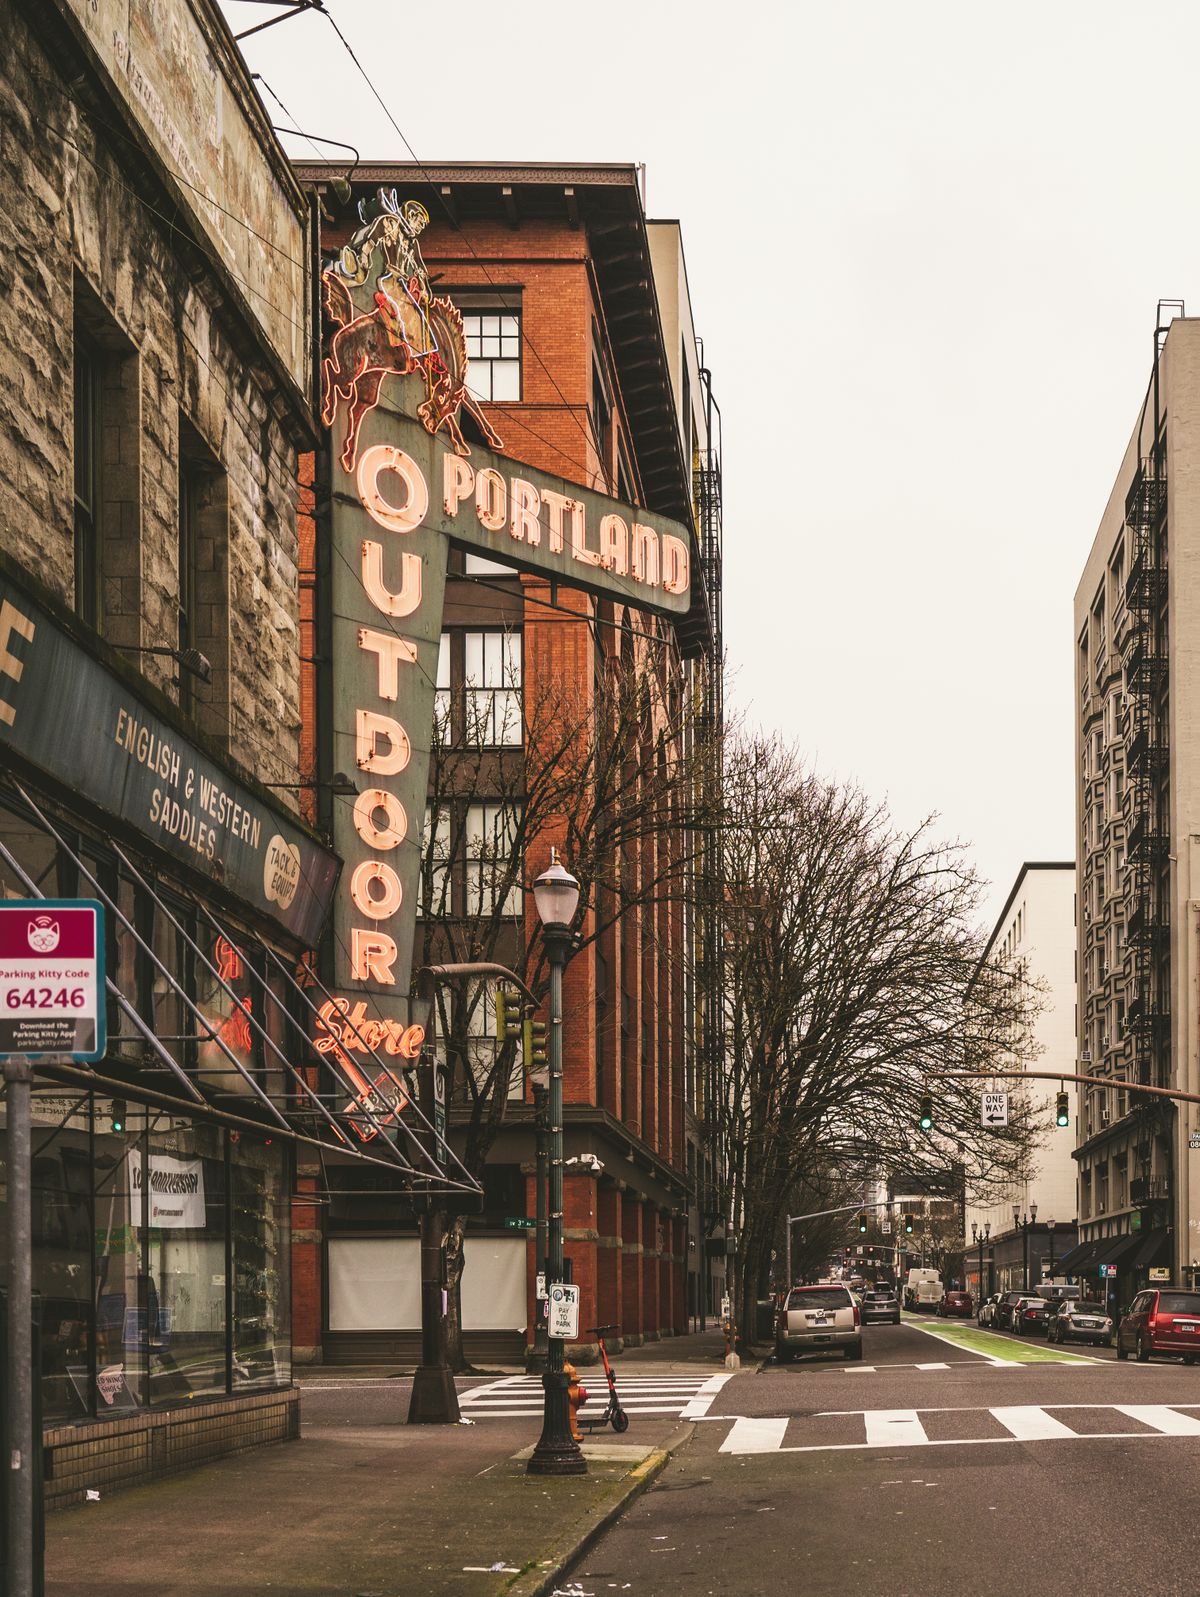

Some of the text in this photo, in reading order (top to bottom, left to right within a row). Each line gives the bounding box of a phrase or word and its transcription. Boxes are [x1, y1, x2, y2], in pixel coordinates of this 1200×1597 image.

[443, 451, 691, 595] PORTLAND
[350, 445, 429, 987] OUTDOOR
[115, 707, 261, 850] ENGLISH & WESTERN
[150, 788, 216, 861] SADDLES
[38, 970, 62, 980] Kitty
[65, 969, 90, 978] Code
[6, 988, 85, 1009] 64246
[13, 1031, 40, 1039] Parking
[41, 1031, 59, 1039] Kitty
[313, 997, 425, 1058] Store
[17, 1039, 72, 1047] parkingkitty.com
[985, 1095, 1004, 1103] ONE
[985, 1104, 1004, 1112] WAY
